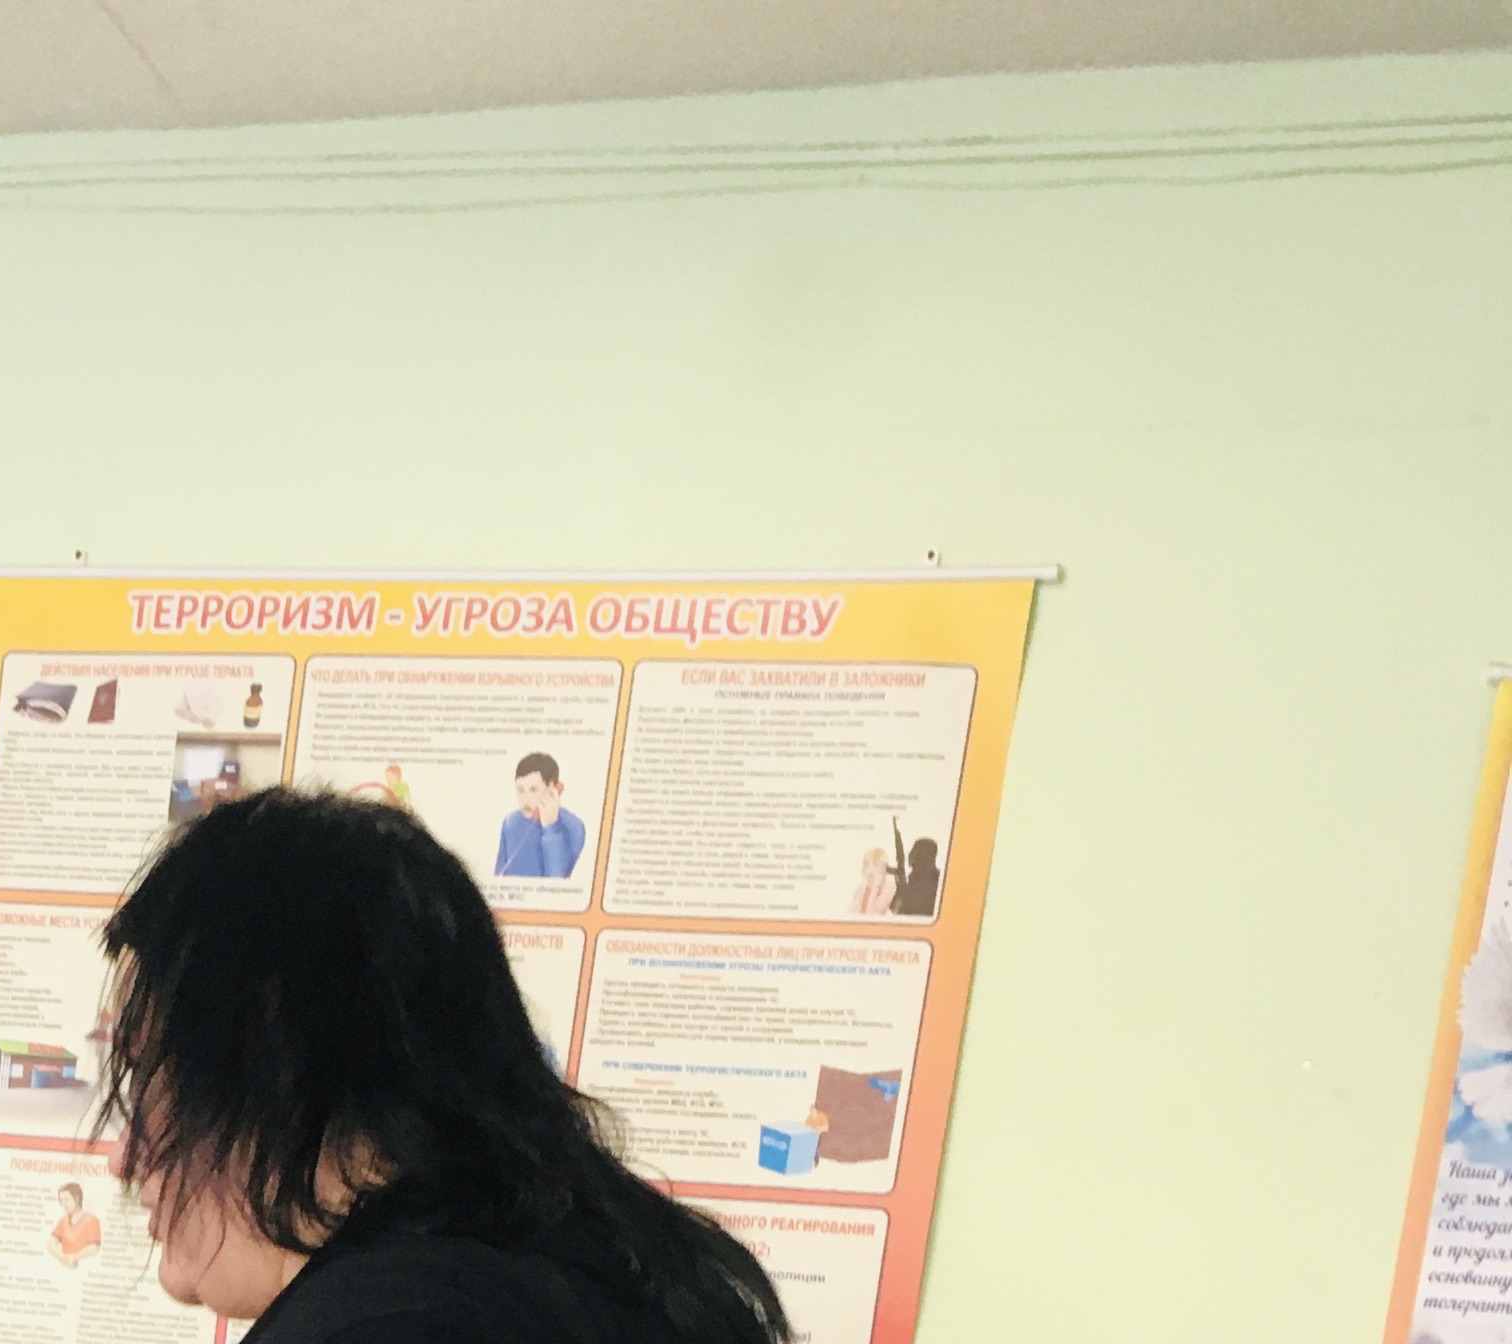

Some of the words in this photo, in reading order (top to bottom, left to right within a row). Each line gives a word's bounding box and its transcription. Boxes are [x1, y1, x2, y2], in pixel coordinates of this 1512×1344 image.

[131, 594, 376, 631] ТЕРРОРИЗМ
[414, 595, 575, 633] УГРОЗА
[589, 597, 839, 643] ОБЩЕСТВУ
[681, 668, 717, 685] ЕСЛИ
[749, 670, 826, 687] ЗАХВАТИЛИ
[842, 671, 926, 688] ЗАЛОЖНИКИ
[10, 1157, 72, 1175] ПОВЕДЕНИЕ
[1449, 1160, 1498, 1180] Наша
[771, 1216, 875, 1236] РЕАГИРОВАНИЯ
